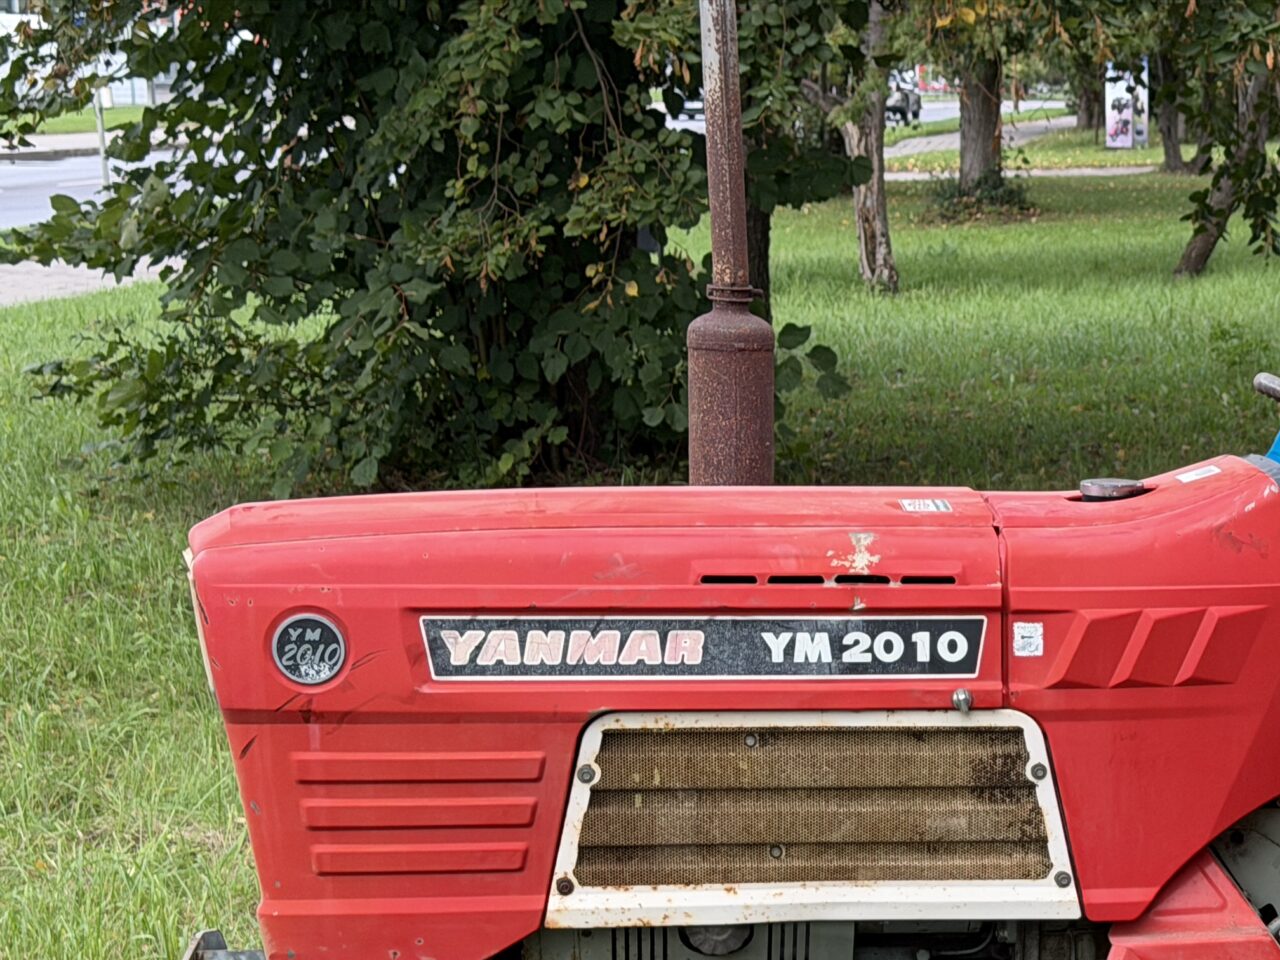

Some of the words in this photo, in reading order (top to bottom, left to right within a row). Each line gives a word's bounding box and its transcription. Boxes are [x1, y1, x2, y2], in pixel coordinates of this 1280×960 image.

[288, 628, 321, 641] YM
[282, 643, 340, 665] 2010
[441, 630, 704, 665] YANMAR
